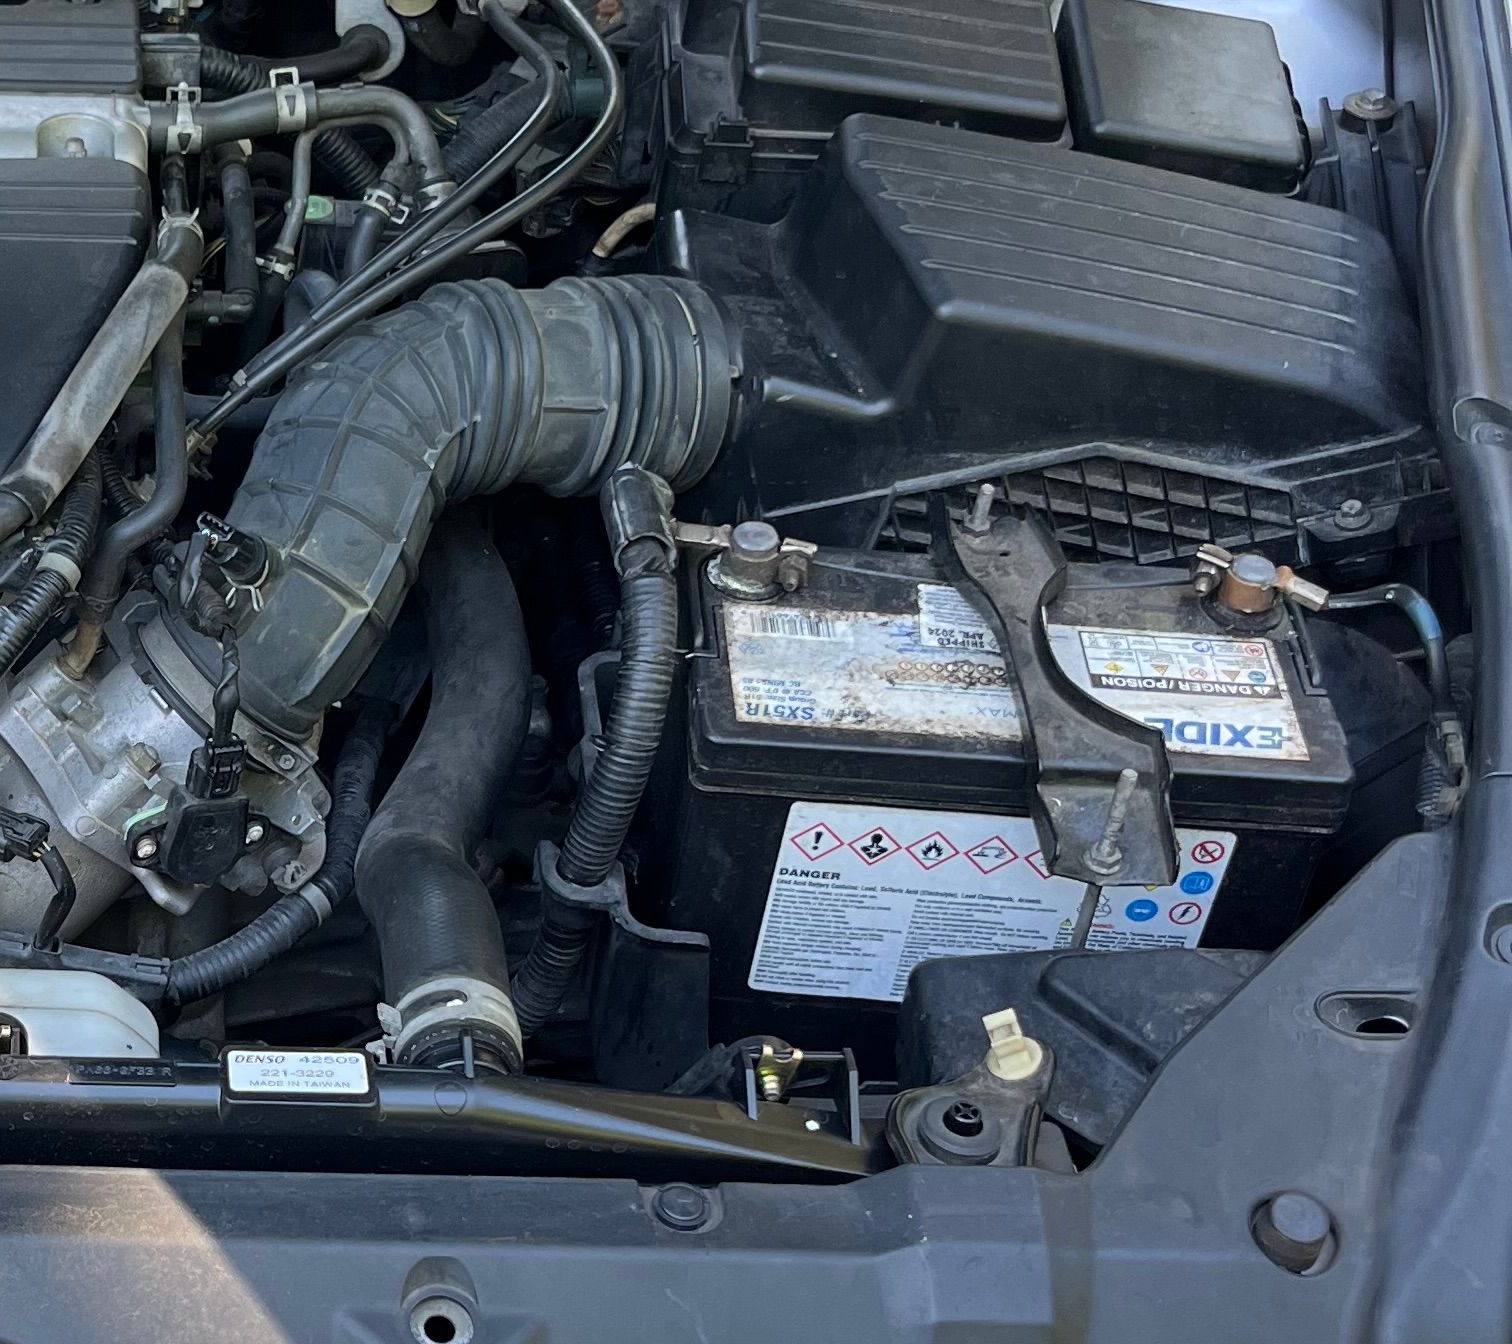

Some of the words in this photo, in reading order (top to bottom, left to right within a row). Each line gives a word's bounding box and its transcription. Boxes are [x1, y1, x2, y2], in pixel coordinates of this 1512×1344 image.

[1100, 675, 1168, 690] POISON
[1178, 682, 1252, 695] DANGER
[745, 702, 816, 721] SX51R
[778, 867, 841, 881] DANGER
[234, 1054, 286, 1064] DENSO
[249, 1079, 284, 1087] MADE
[303, 1080, 352, 1088] TAIWAN
